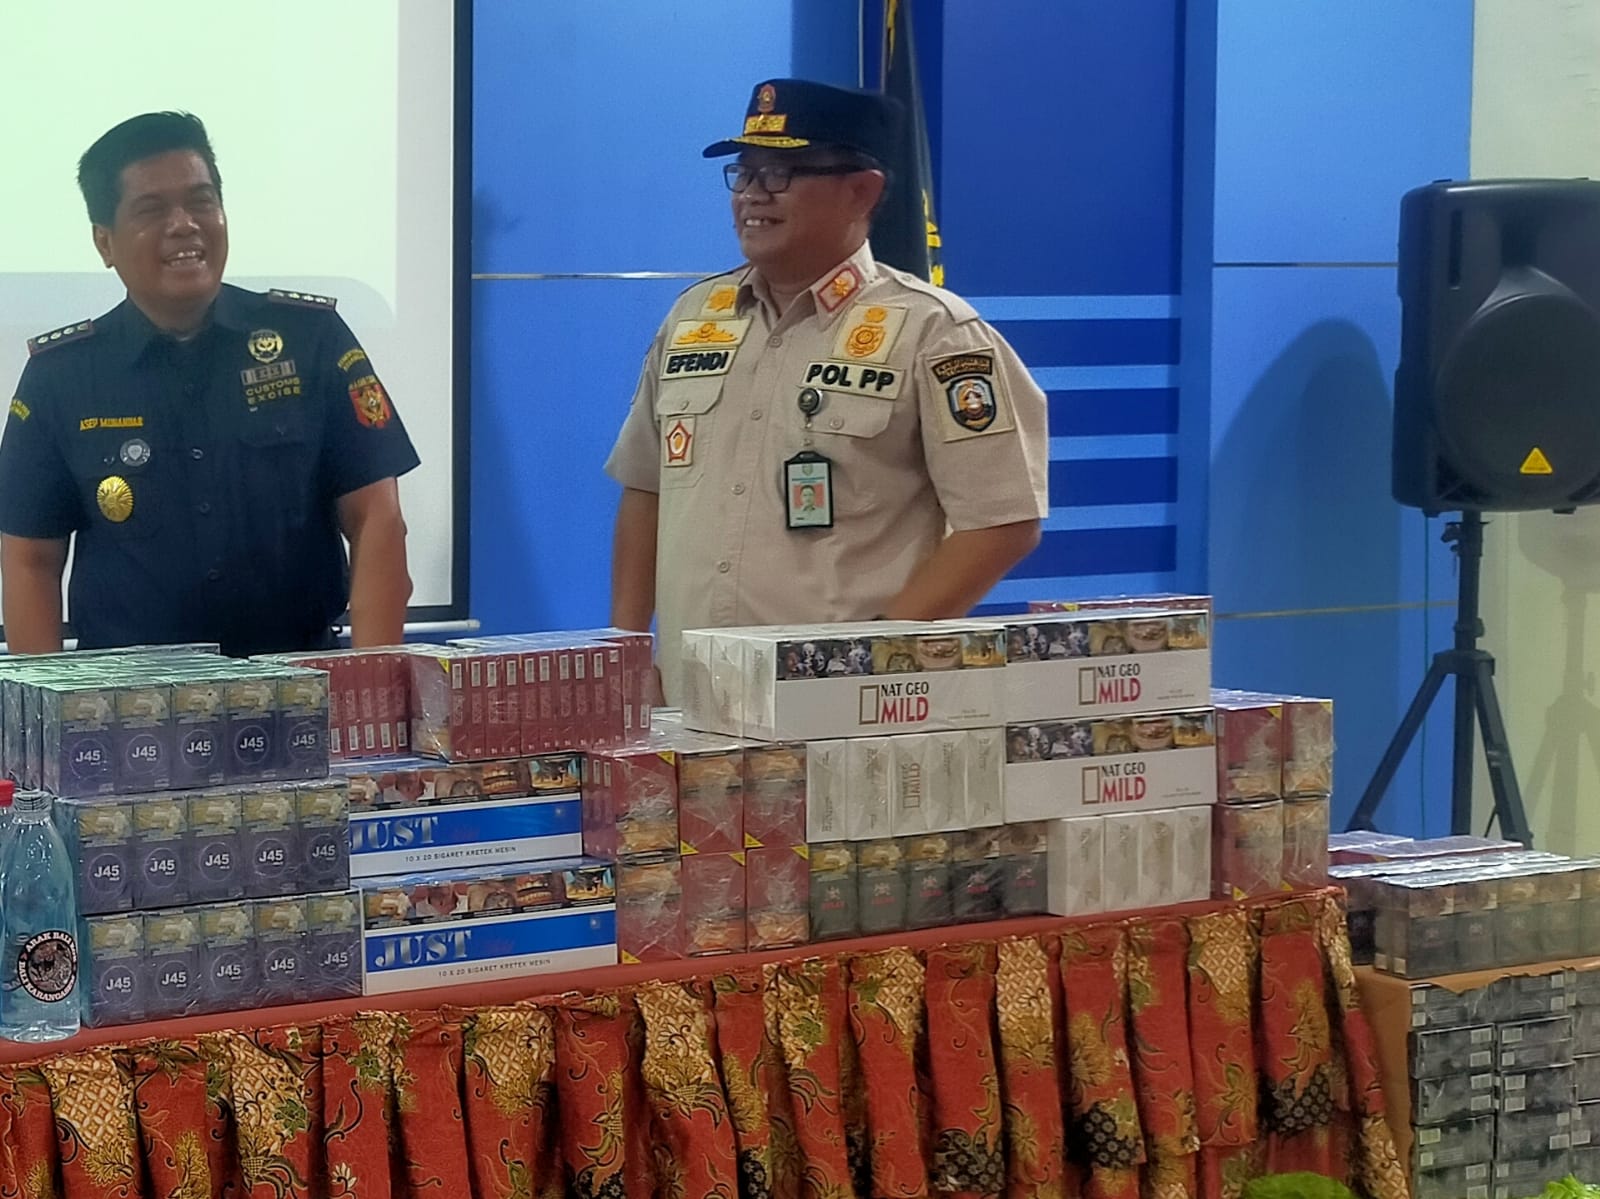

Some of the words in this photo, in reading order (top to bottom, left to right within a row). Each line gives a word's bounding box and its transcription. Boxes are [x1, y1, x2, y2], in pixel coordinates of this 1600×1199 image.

[666, 351, 729, 374] EFENDI
[806, 364, 852, 387] POL
[859, 368, 894, 391] PP
[245, 376, 300, 397] CUSTOMS
[247, 386, 301, 404] EXCISE
[1097, 665, 1116, 678] NAT
[1119, 663, 1141, 677] GEO
[880, 683, 902, 697] NAT
[906, 681, 929, 696] GEO
[1098, 677, 1141, 704] MILD
[880, 696, 929, 723] MILD
[186, 740, 211, 754] J45
[239, 736, 264, 750] J45
[292, 734, 316, 746] J45
[75, 750, 101, 764] J45
[132, 745, 157, 759] J45
[1101, 763, 1121, 777] NAT
[1123, 761, 1146, 776] GEO
[1102, 776, 1146, 803] MILD
[347, 816, 438, 849] JUST
[258, 849, 283, 862] J45
[312, 845, 336, 857] J45
[405, 855, 415, 863] 10
[423, 853, 432, 861] 20
[433, 851, 464, 860] SIGARET
[466, 848, 492, 857] KRETEK
[495, 846, 517, 855] MESIN
[150, 859, 175, 872] J45
[205, 853, 230, 867] J45
[94, 864, 120, 878] J45
[25, 932, 51, 952] ARAK
[375, 930, 472, 968] JUST
[270, 958, 295, 971] J45
[324, 952, 348, 965] J45
[216, 964, 241, 978] J45
[467, 964, 498, 975] SIGARET
[500, 961, 527, 971] KRETEK
[106, 977, 131, 991] J45
[162, 972, 187, 985] J45
